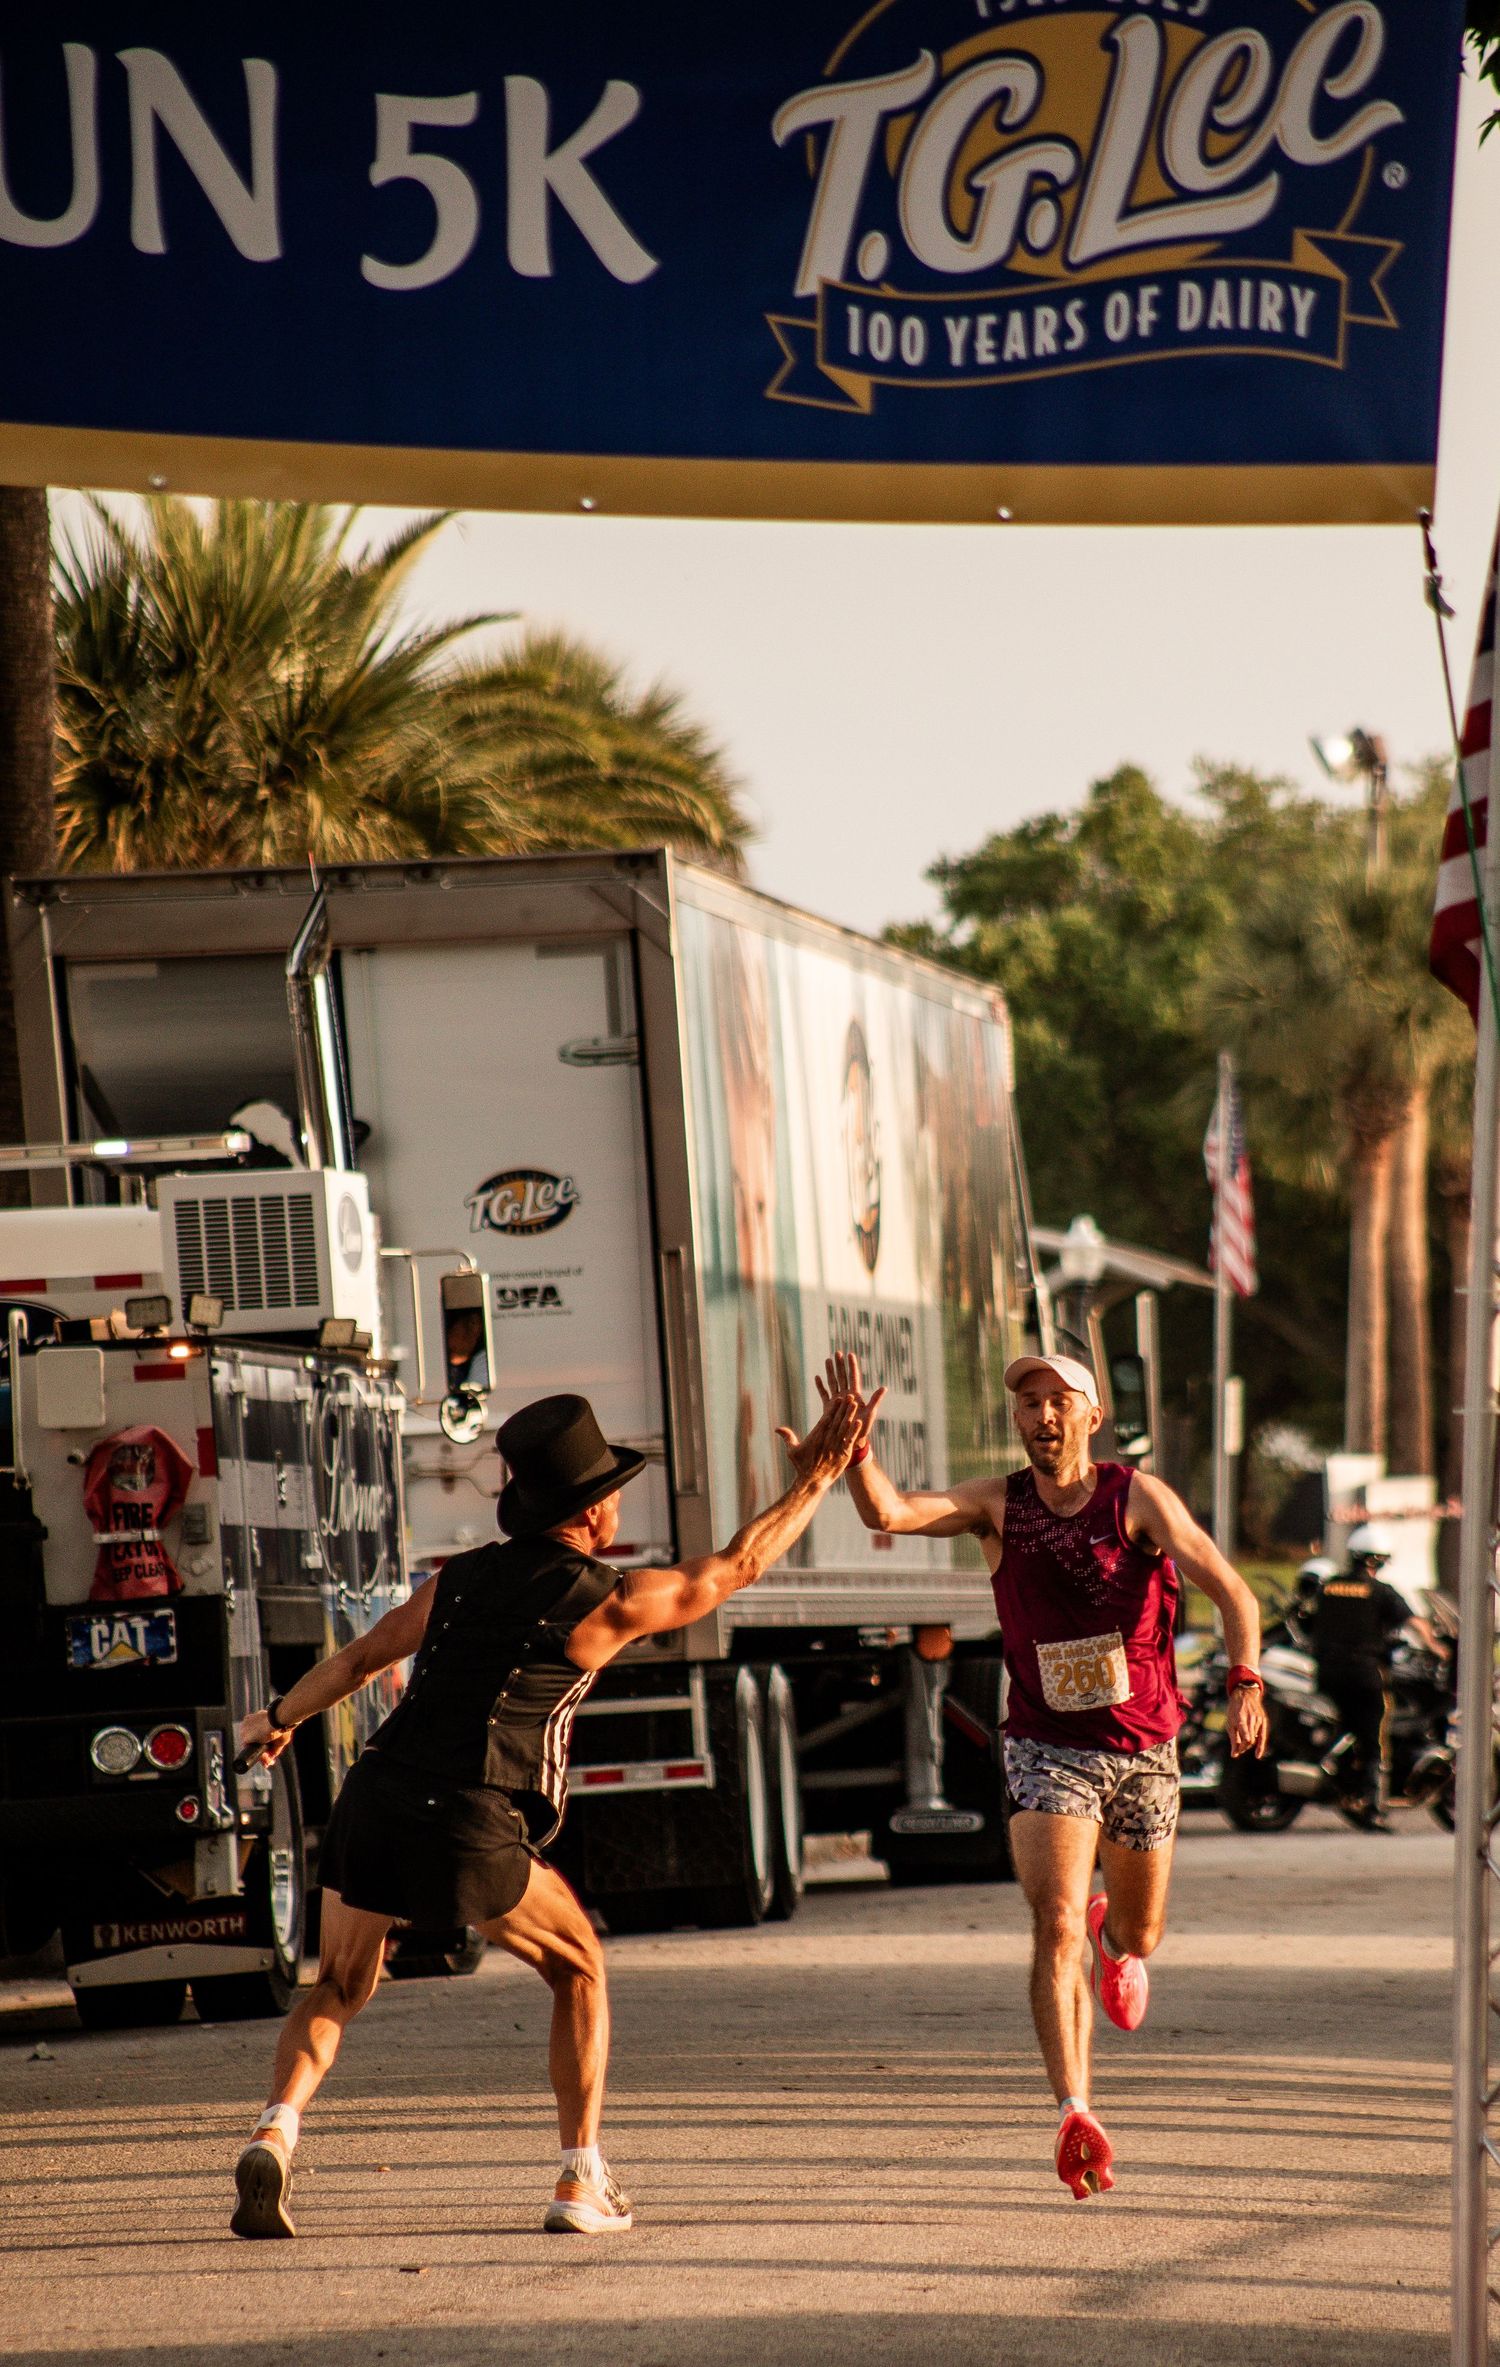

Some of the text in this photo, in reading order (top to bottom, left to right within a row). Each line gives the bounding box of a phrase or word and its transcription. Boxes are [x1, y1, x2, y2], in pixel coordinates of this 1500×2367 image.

[361, 74, 660, 290] 5K
[846, 278, 1317, 367] 100 YEARS OF DAIRY
[112, 1502, 154, 1530] FIRE
[91, 1620, 149, 1659] CAT
[1053, 1655, 1117, 1696] 260
[124, 1916, 245, 1943] KENWORTH
